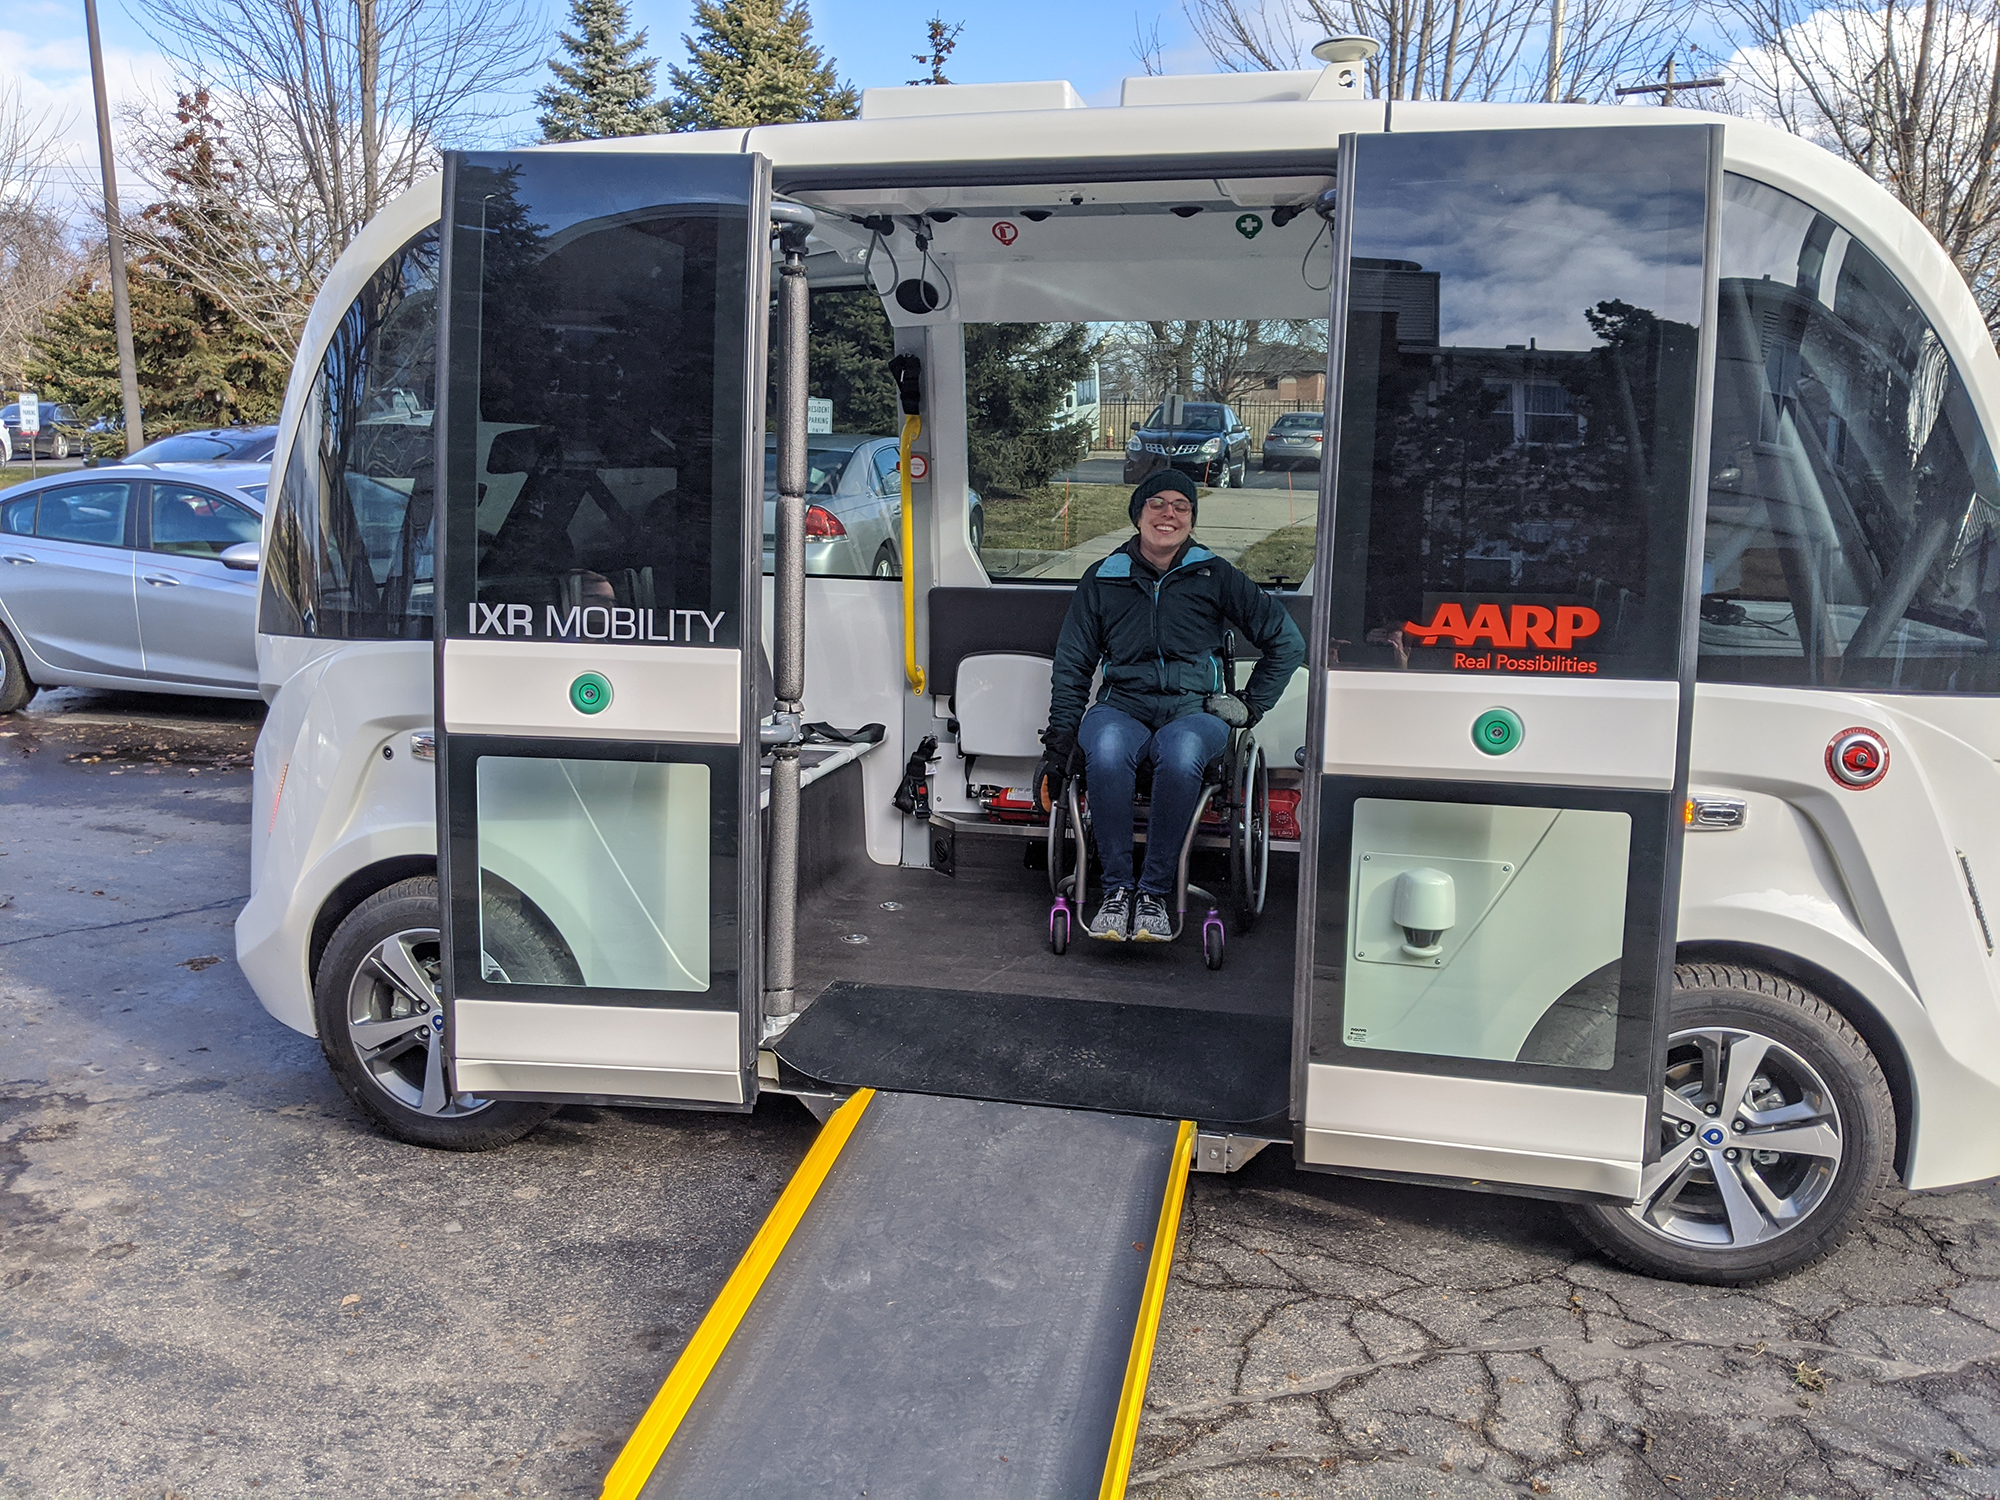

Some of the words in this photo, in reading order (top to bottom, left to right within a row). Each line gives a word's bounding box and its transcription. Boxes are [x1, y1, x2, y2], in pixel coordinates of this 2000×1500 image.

[808, 405, 830, 413] RESIDENT
[808, 416, 829, 424] PARKING
[468, 602, 534, 636] IXR
[546, 604, 726, 643] MOBILITY
[1403, 602, 1601, 649] AARP
[1454, 652, 1491, 669] Real
[1496, 653, 1598, 673] Possibilities
